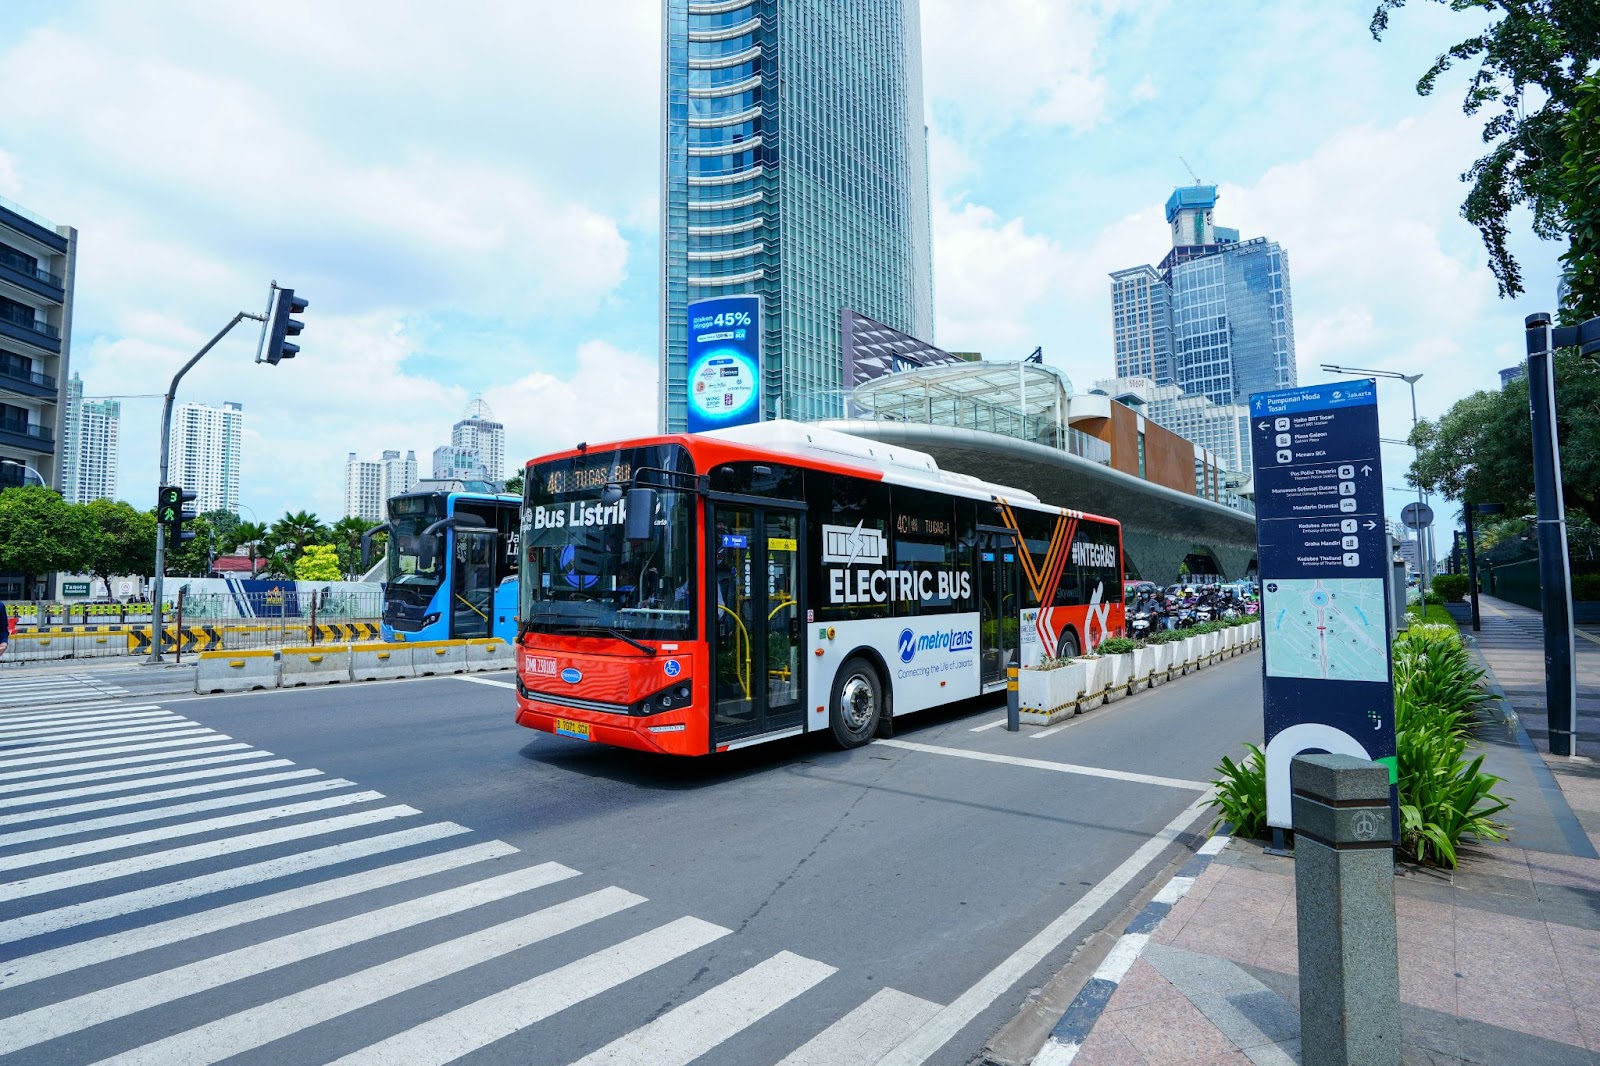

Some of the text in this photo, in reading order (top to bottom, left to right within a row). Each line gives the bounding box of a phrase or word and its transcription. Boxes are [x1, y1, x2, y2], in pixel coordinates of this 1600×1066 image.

[694, 316, 714, 324] Diskon
[714, 312, 752, 326] 45%
[1267, 396, 1301, 406] Pumpunan
[1302, 393, 1320, 402] Moda
[1268, 404, 1286, 412] Tosari
[547, 471, 562, 494] 4C
[170, 491, 177, 502] 3
[535, 506, 564, 530] Bus
[897, 514, 908, 534] 4C
[1072, 542, 1116, 568] #INTEGRASI
[830, 568, 933, 604] ELECTRIC
[938, 570, 971, 601] BUS
[1057, 588, 1080, 598] Skywell
[917, 628, 972, 652] metrotrans
[527, 657, 536, 672] DMR
[898, 666, 930, 679] Connecting
[931, 665, 939, 673] the
[950, 661, 954, 670] of
[956, 660, 972, 669] Jakarta
